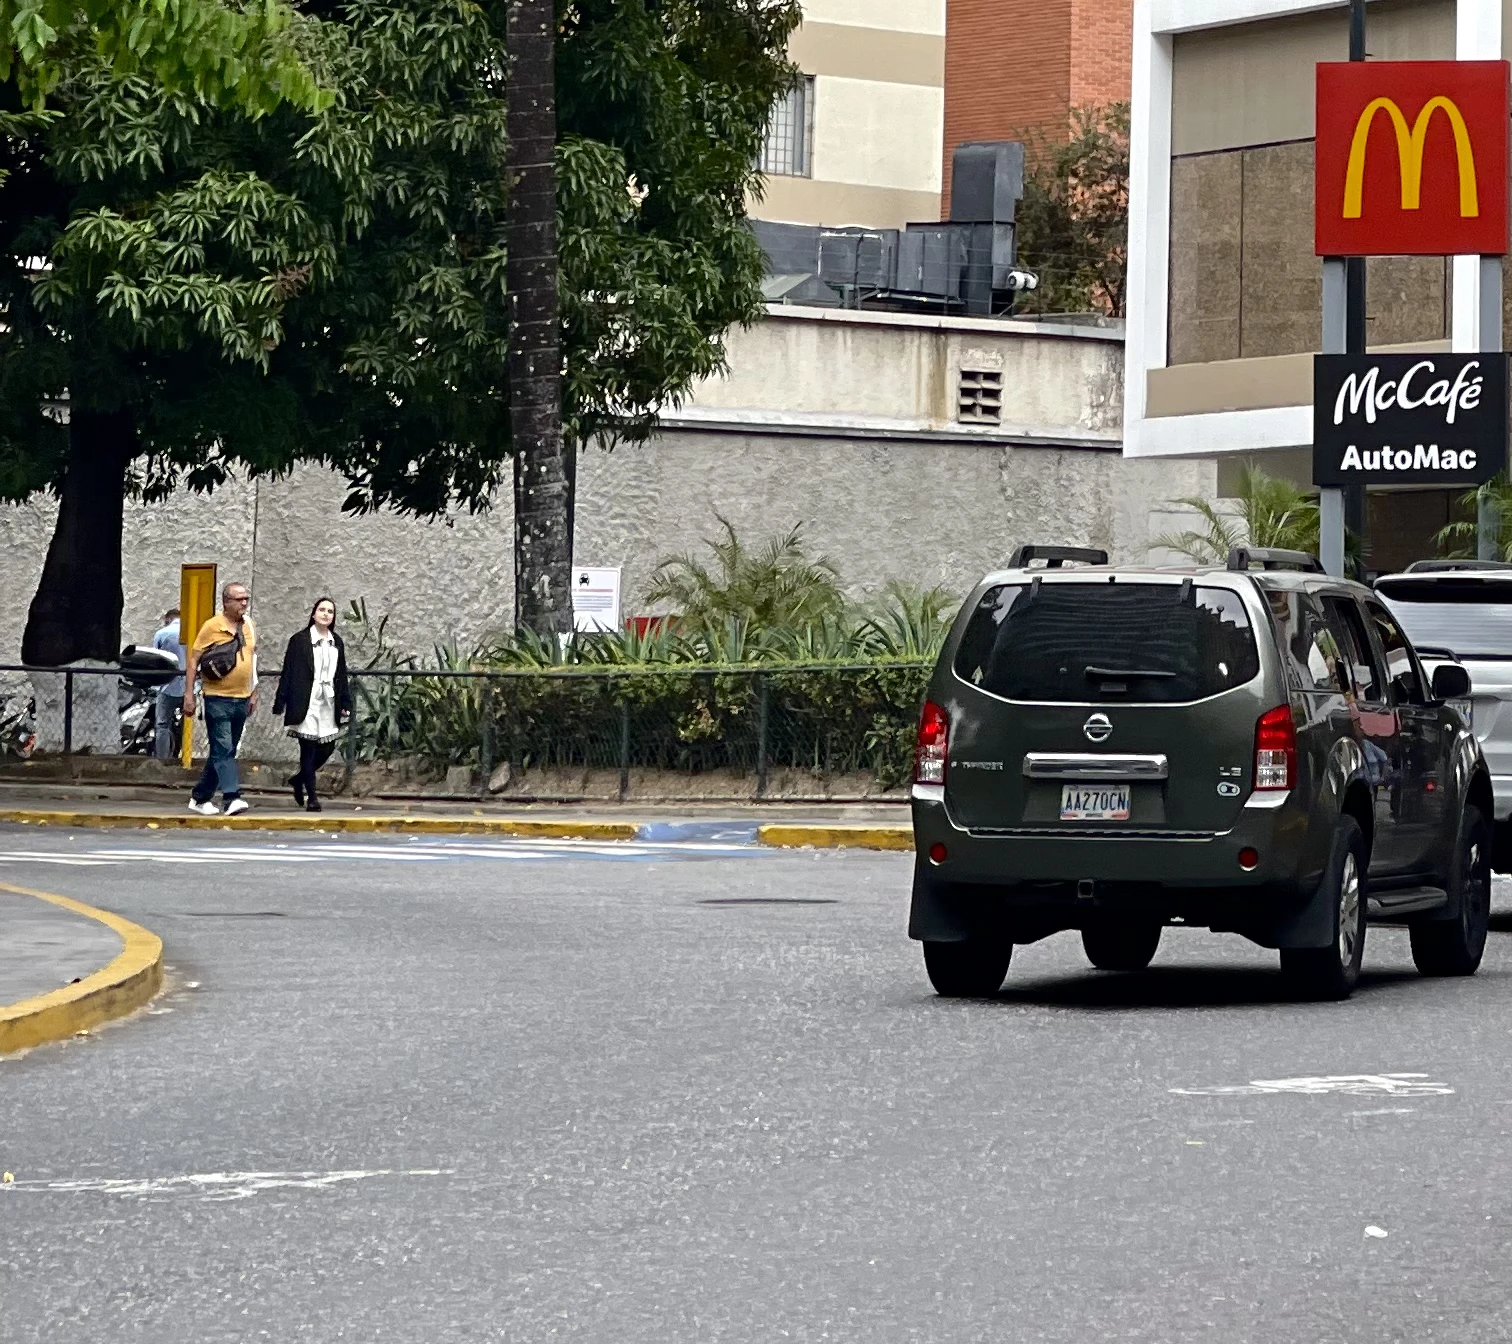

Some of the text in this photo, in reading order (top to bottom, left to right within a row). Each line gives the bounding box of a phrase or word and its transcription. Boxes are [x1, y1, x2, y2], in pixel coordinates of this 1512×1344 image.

[1333, 360, 1484, 425] McCafé
[1340, 444, 1477, 471] AutoMac
[1065, 791, 1126, 811] AA270CN
